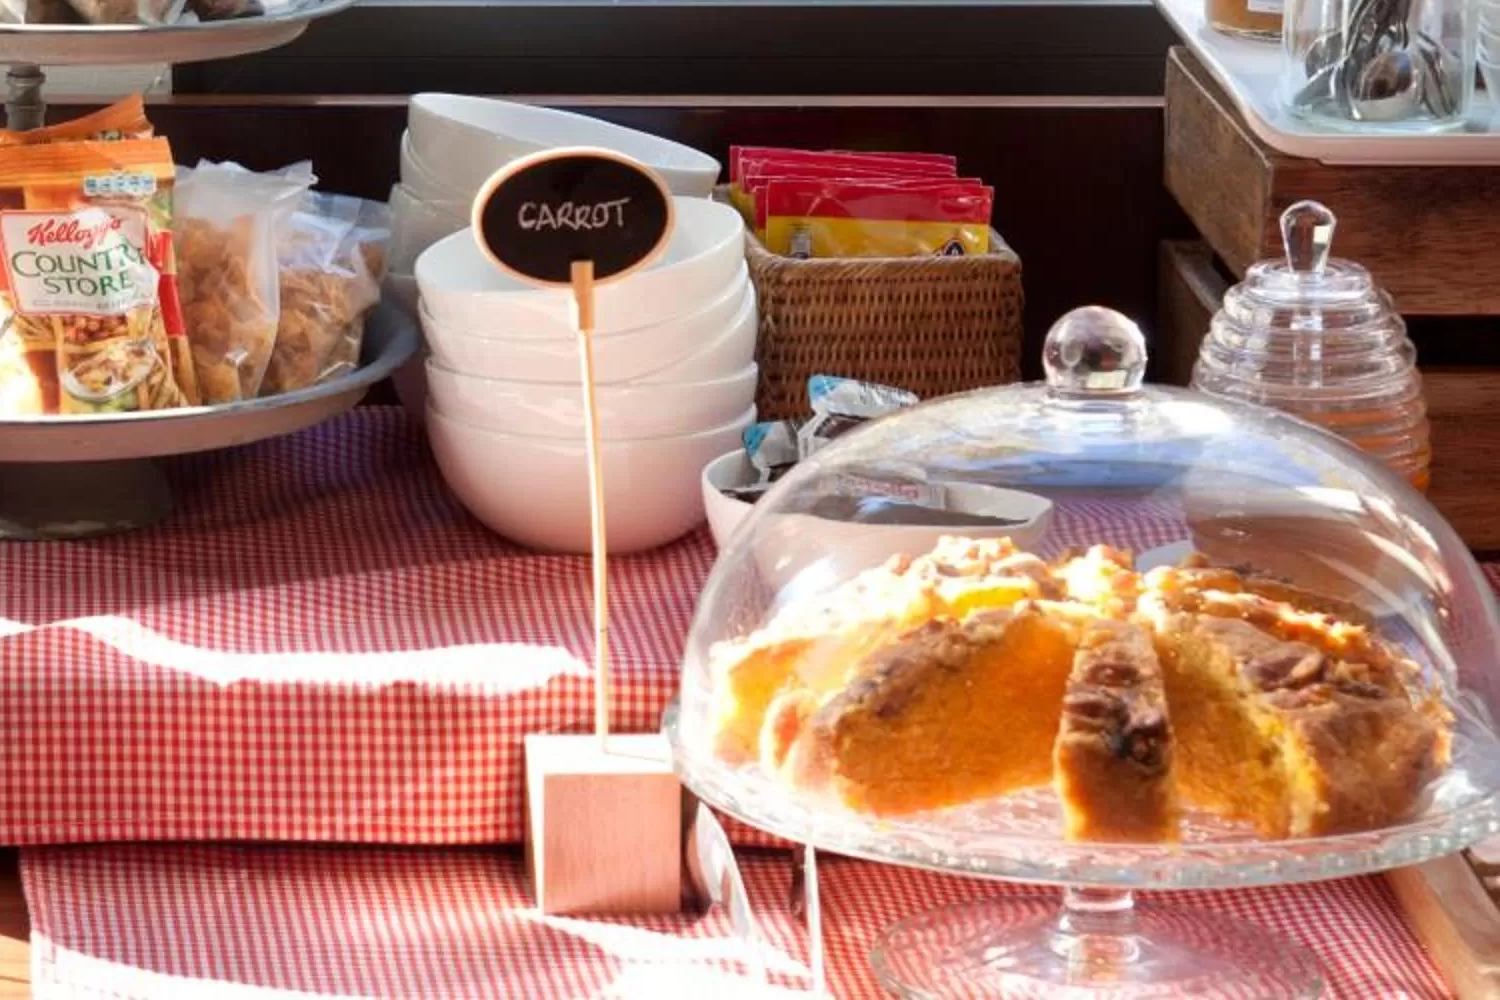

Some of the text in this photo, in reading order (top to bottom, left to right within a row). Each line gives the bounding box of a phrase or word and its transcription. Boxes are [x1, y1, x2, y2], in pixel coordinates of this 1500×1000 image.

[518, 197, 632, 231] CARROT
[27, 214, 123, 250] Kellogg's
[43, 270, 134, 298] STORE
